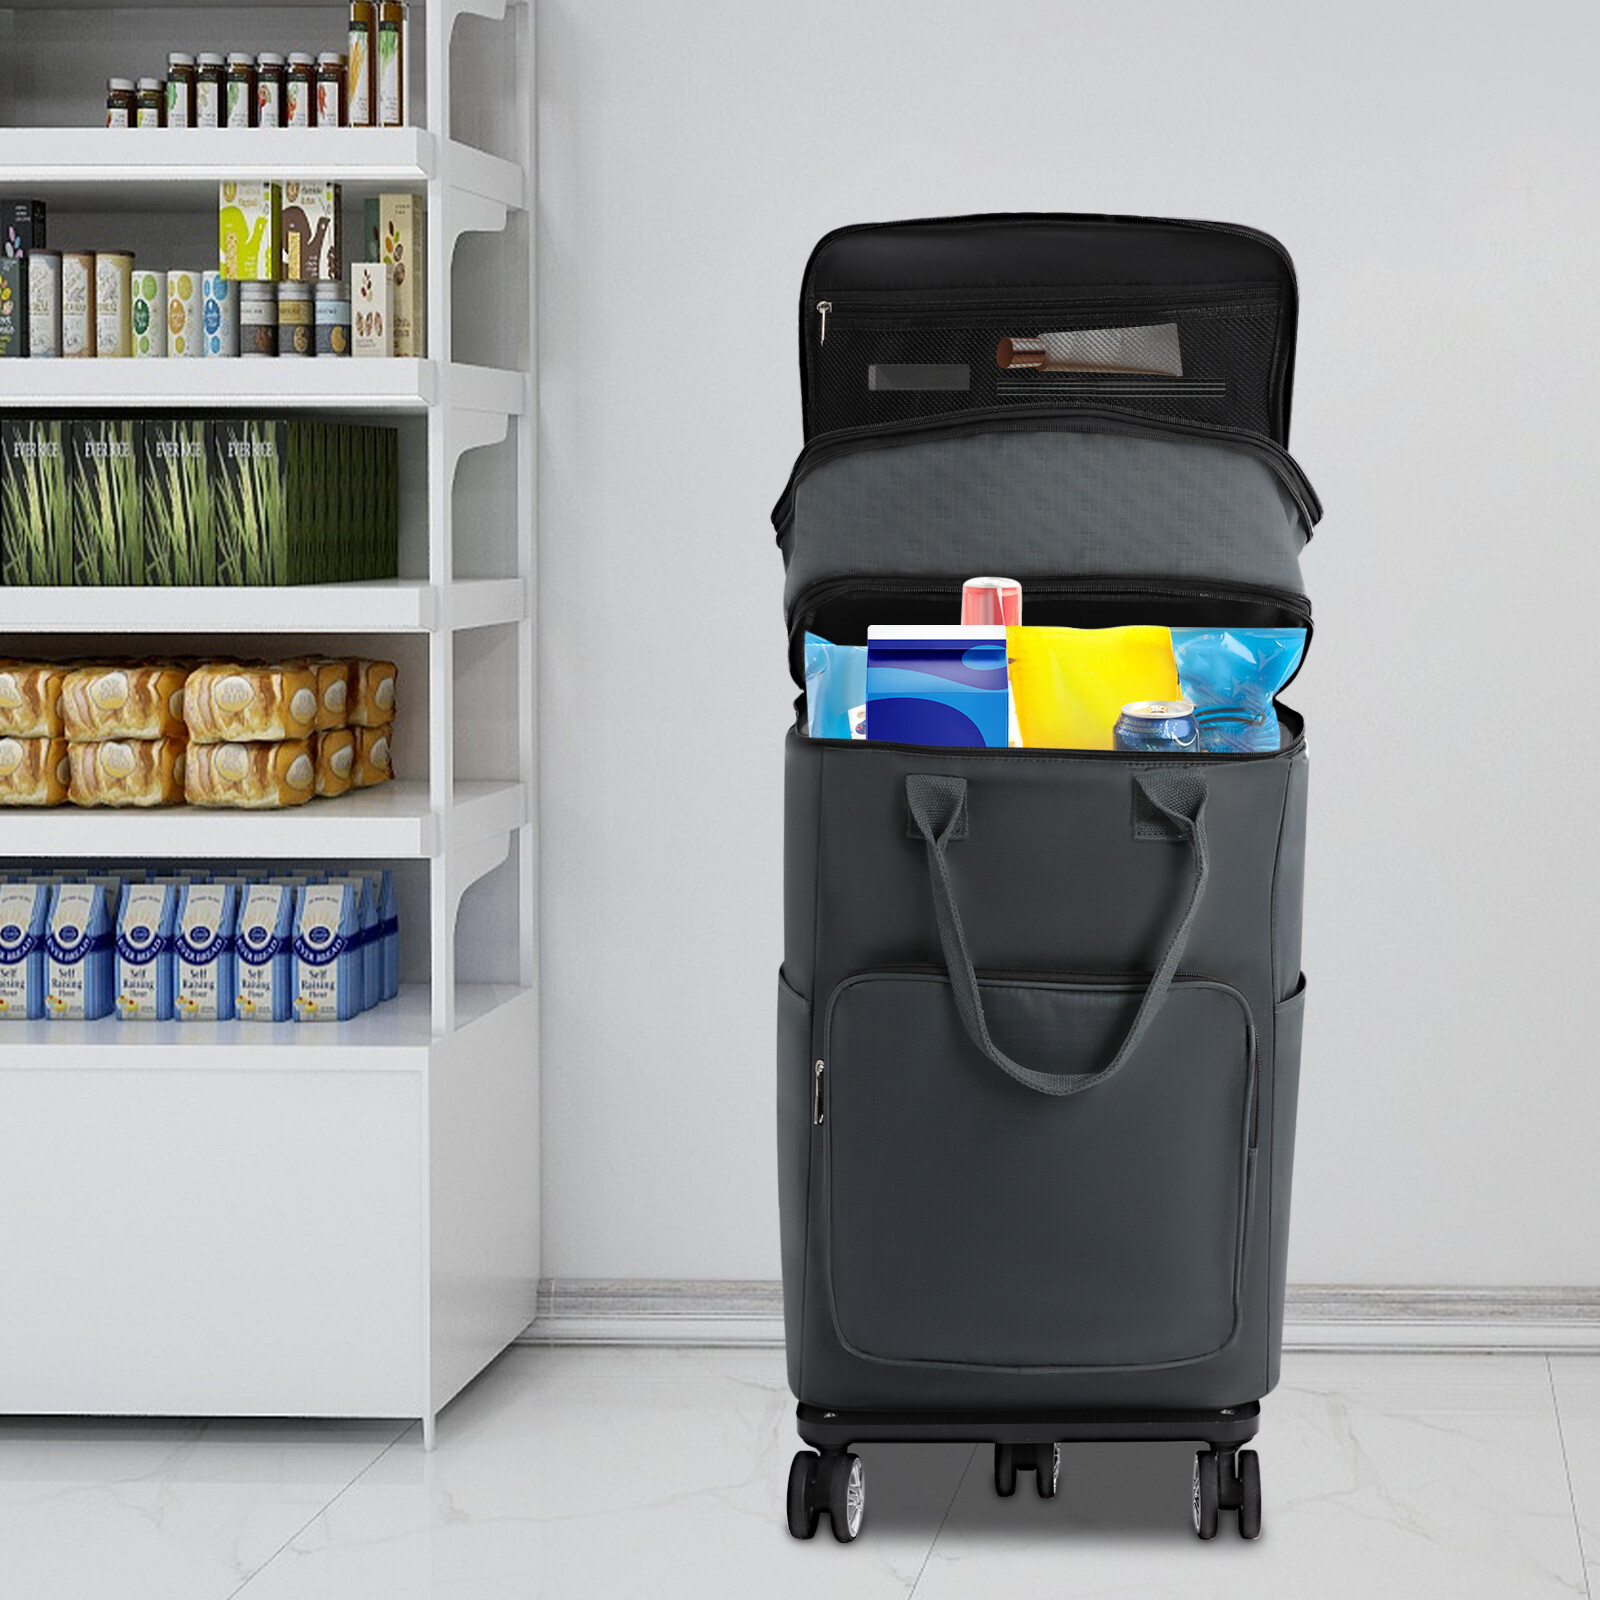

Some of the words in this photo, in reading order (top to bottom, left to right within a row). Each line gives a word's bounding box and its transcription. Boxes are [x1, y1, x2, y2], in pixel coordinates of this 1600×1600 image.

[58, 968, 75, 978] Self
[130, 969, 146, 978] Self
[190, 969, 207, 978] Self
[247, 969, 264, 978] Self
[308, 969, 327, 978] Self
